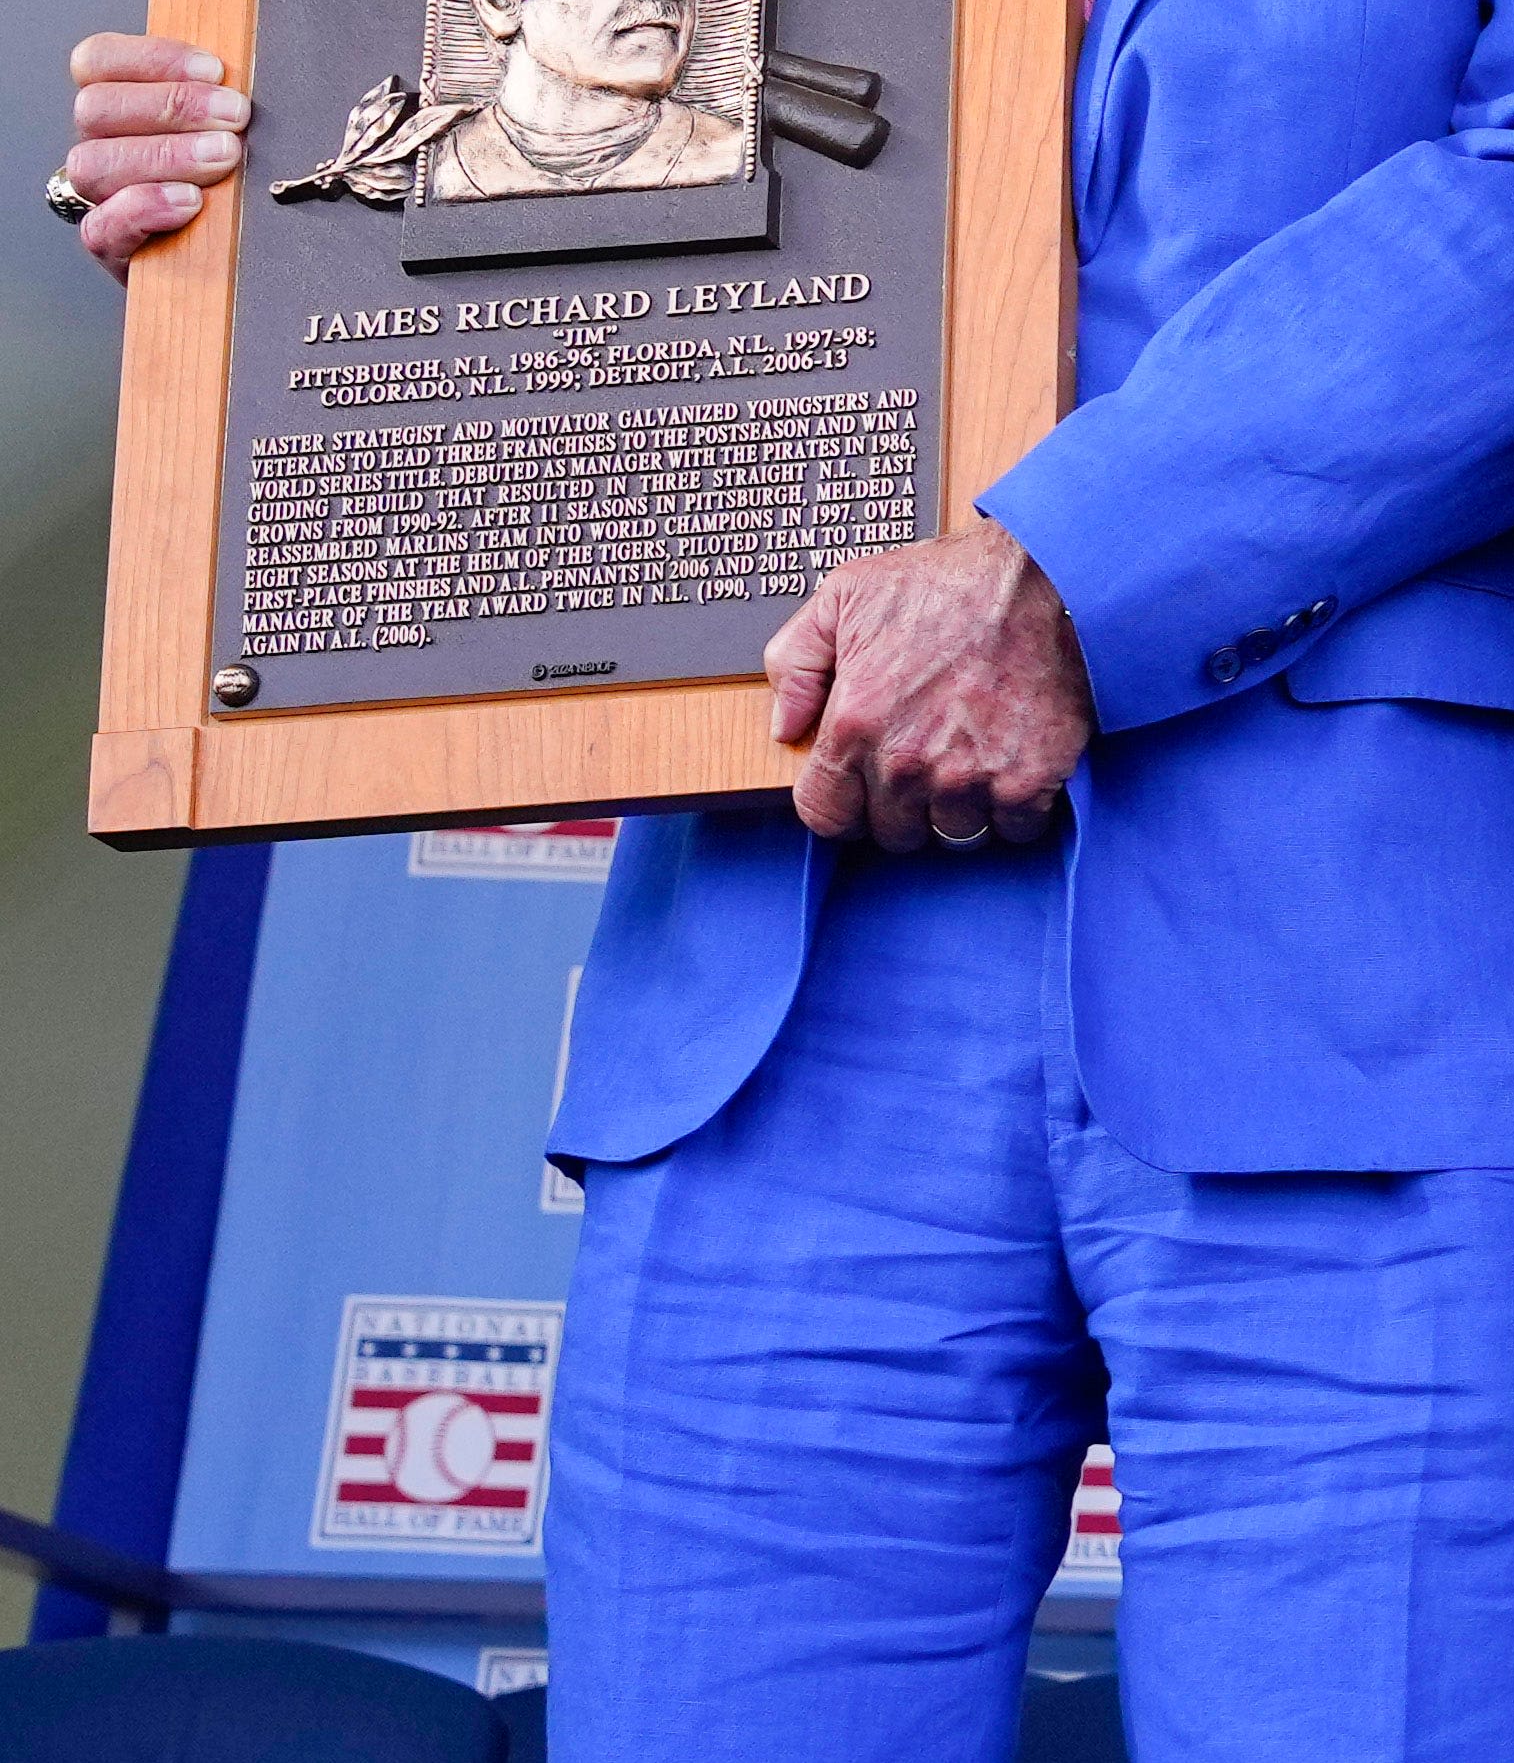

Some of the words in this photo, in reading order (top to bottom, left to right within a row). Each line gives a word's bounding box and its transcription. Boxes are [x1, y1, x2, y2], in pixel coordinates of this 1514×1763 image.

[302, 305, 439, 342] JAMES
[455, 290, 650, 330] RICHARD
[665, 273, 870, 314] LEYLAND
[287, 358, 446, 388] PITTSBURGH,
[453, 354, 500, 376] N.L.
[509, 346, 600, 370] 1986-96;
[606, 338, 720, 364] FLORIDA,
[726, 334, 775, 355] N.L.
[783, 326, 874, 350] 1997-98;
[320, 378, 461, 406] COLORADO,
[468, 374, 515, 395] N.L.
[524, 369, 580, 391] 1999;
[588, 360, 700, 386] DETROIT,
[707, 356, 754, 377] A.L.
[761, 348, 847, 373] 2006-13
[251, 433, 324, 456] MASTER
[332, 423, 446, 451] STRATEGIST
[451, 420, 493, 441] AND
[500, 411, 609, 438] MOTIVATOR
[617, 402, 738, 428] GALVANIZED
[746, 391, 868, 419] YOUNGSTERS
[876, 388, 917, 409] AND
[240, 632, 300, 655] AGAIN
[304, 630, 325, 651] IN
[329, 628, 366, 649] A.L.
[371, 623, 431, 650] (2006).
